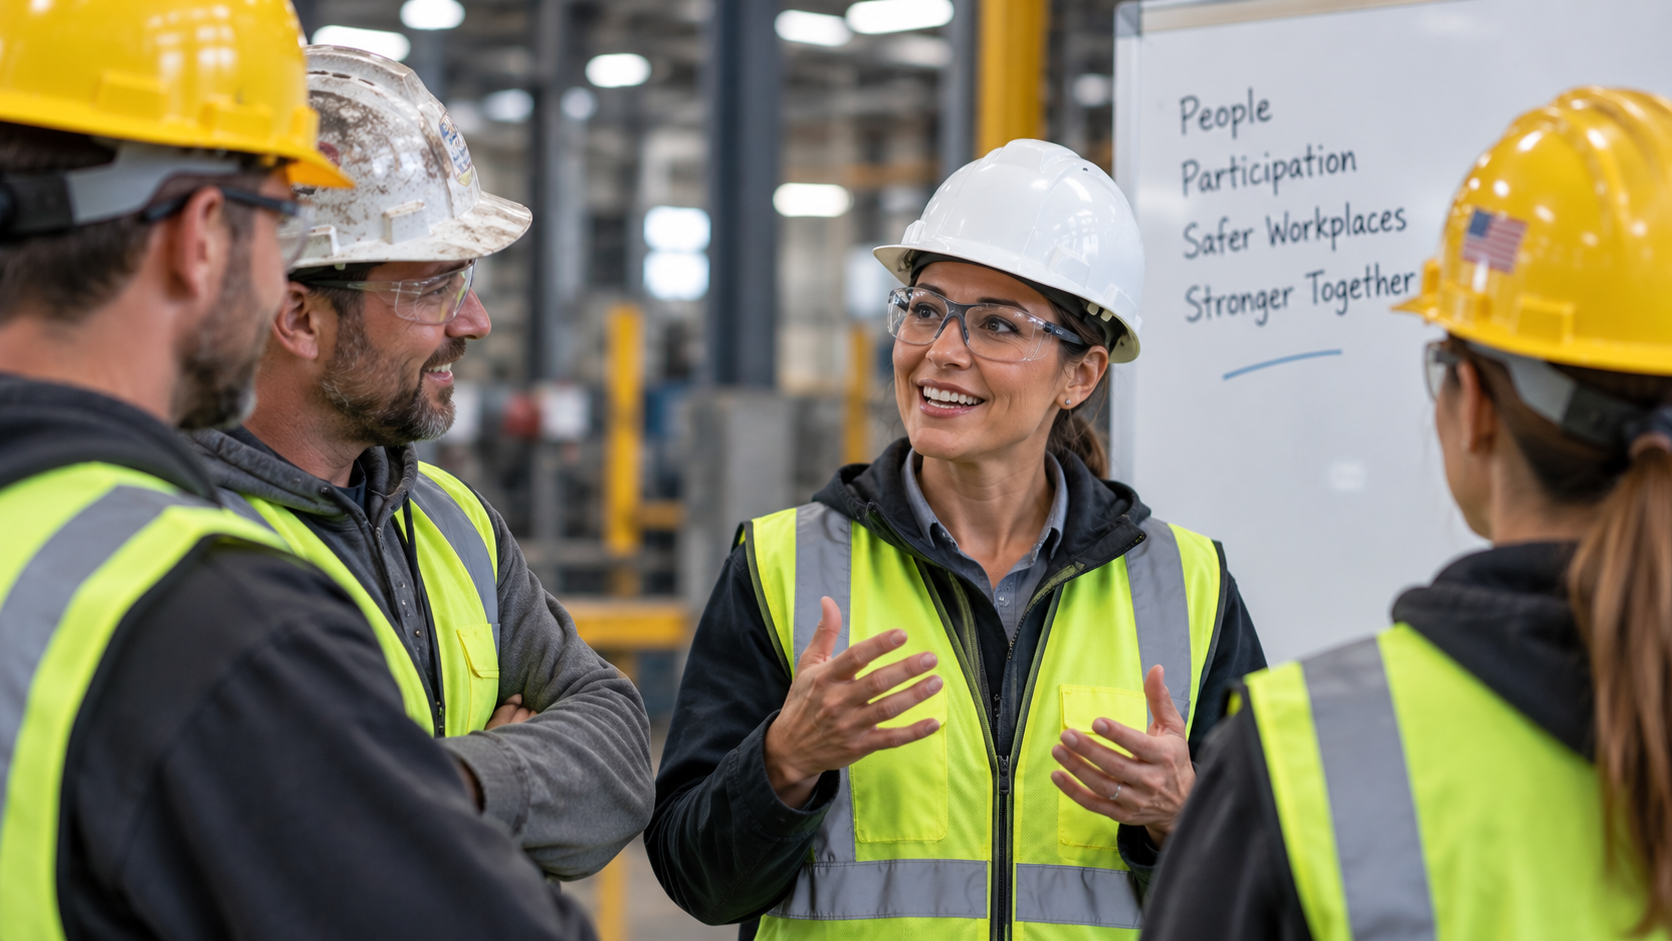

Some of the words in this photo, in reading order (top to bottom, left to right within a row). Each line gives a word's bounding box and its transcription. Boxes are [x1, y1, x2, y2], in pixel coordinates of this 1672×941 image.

[1179, 87, 1273, 140] People
[1181, 144, 1357, 197] Participation
[1183, 215, 1254, 260] Safer
[1265, 201, 1408, 252] Workplaces
[1185, 284, 1294, 327] Stronger
[1305, 262, 1416, 316] Together
